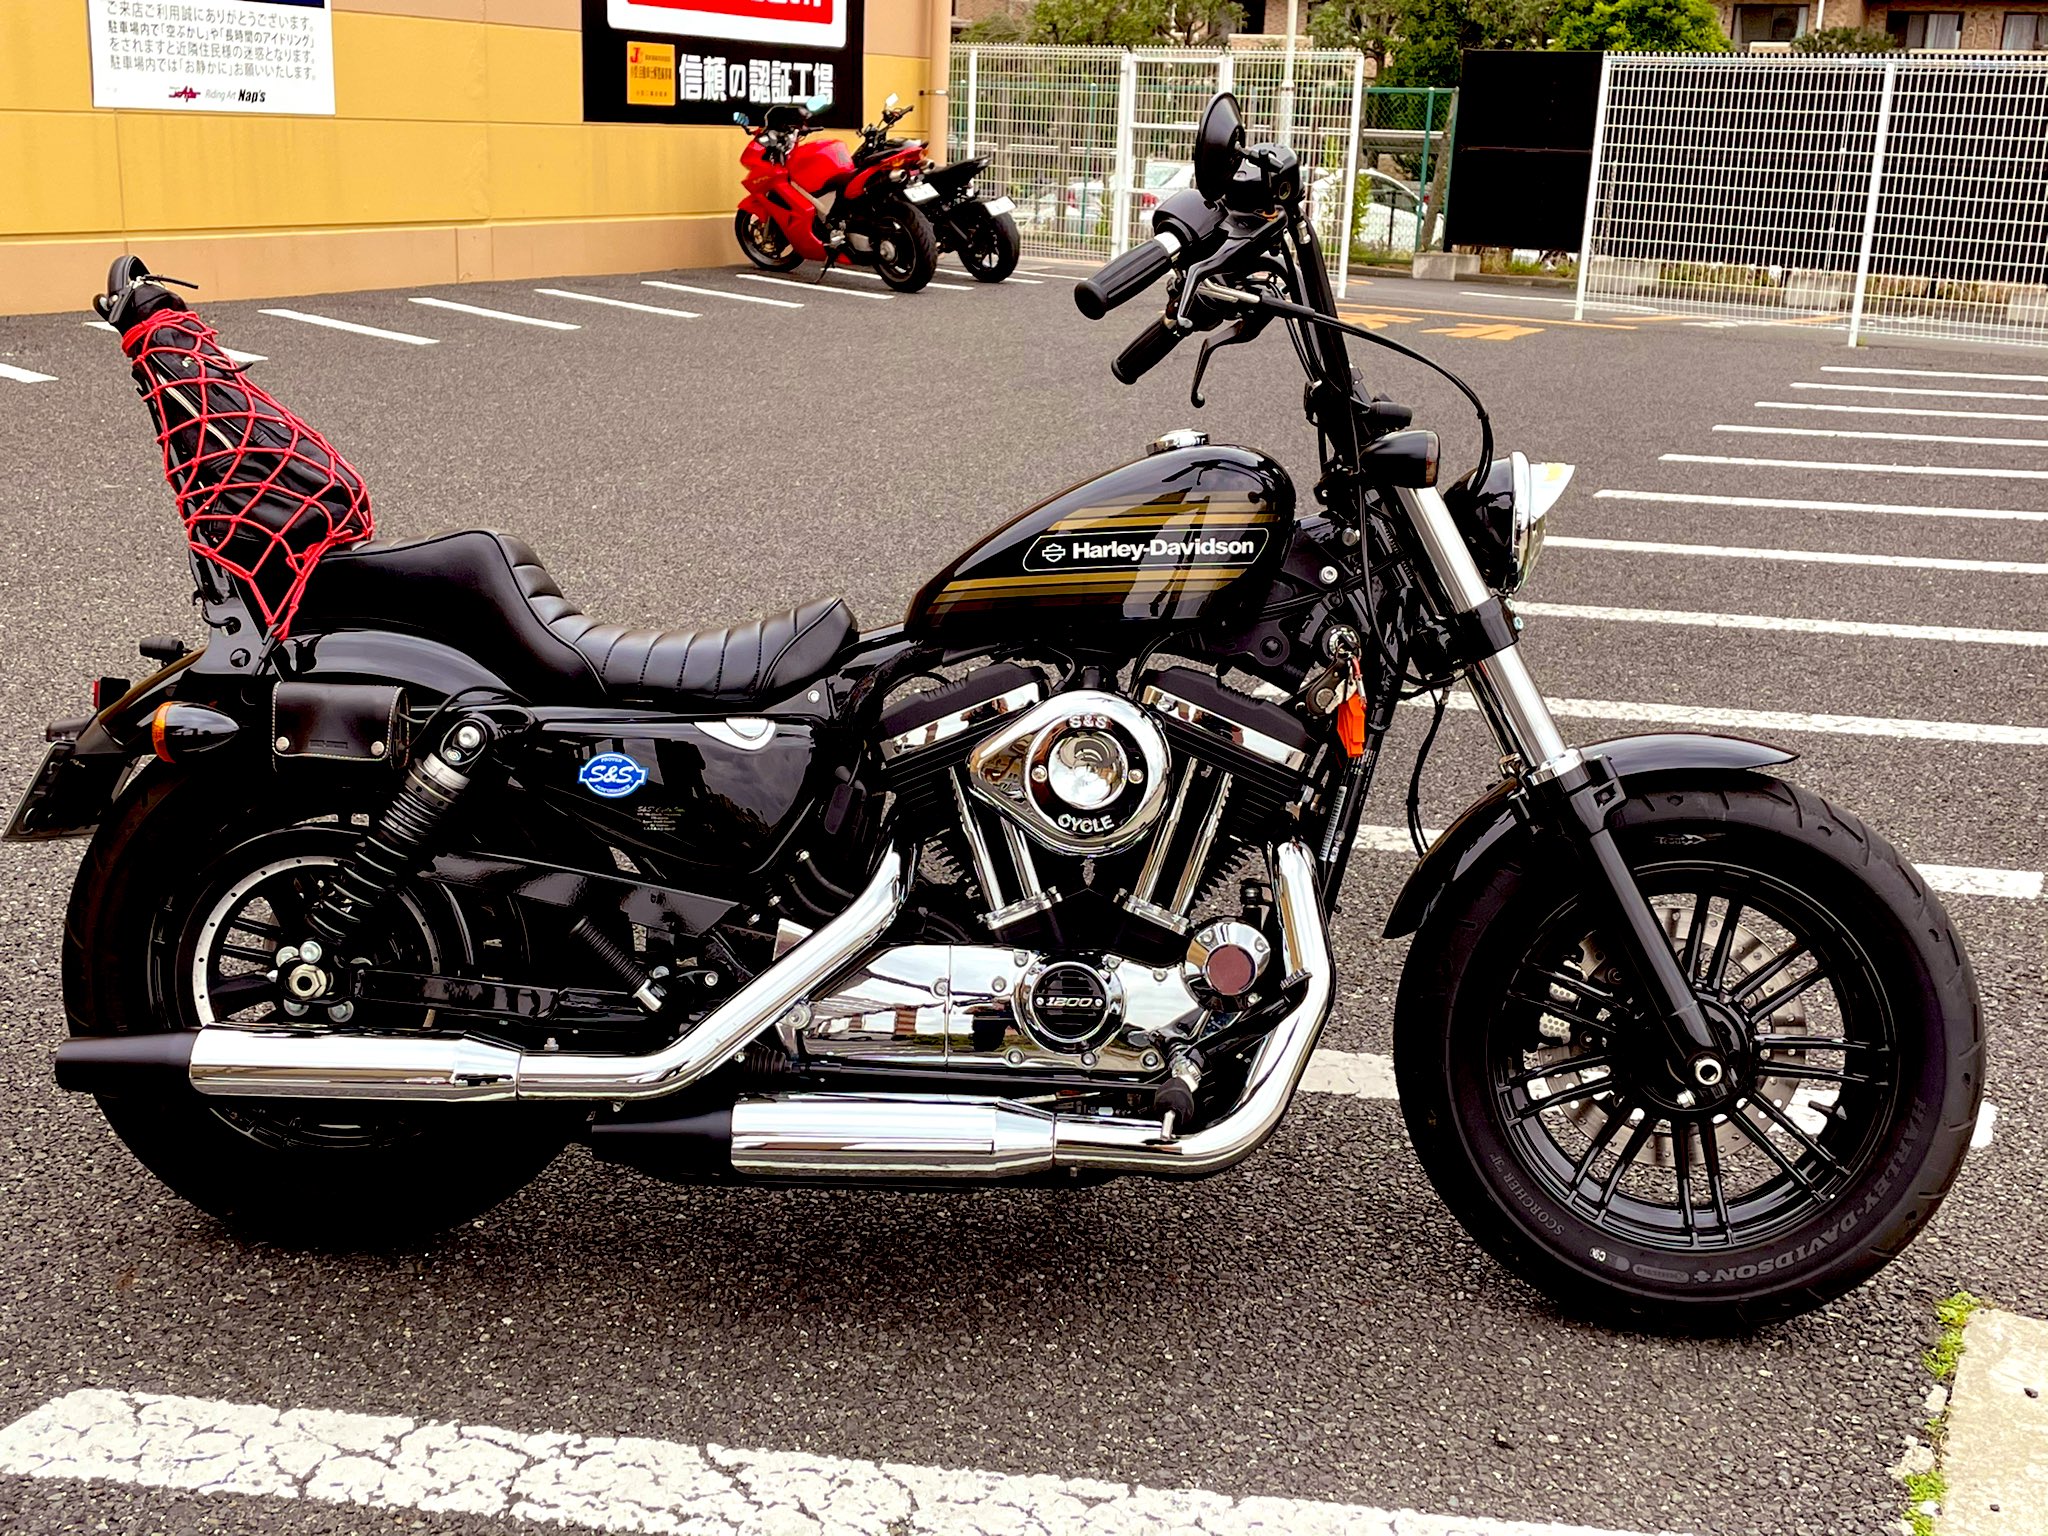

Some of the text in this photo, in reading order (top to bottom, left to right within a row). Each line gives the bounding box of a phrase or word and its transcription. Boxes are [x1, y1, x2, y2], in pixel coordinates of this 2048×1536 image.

[679, 53, 834, 105] 信頼の認証工場
[205, 89, 225, 102] Riding
[238, 89, 266, 103] Nap's
[1072, 538, 1254, 560] Harley-Davidson
[1069, 715, 1109, 729] S&S
[588, 765, 635, 783] S&S
[1057, 813, 1115, 833] CYCLE
[1046, 996, 1094, 1008] 1200
[1712, 1097, 1927, 1284] HARLEY-DAVIDSON
[1503, 1172, 1565, 1236] SCORCHER
